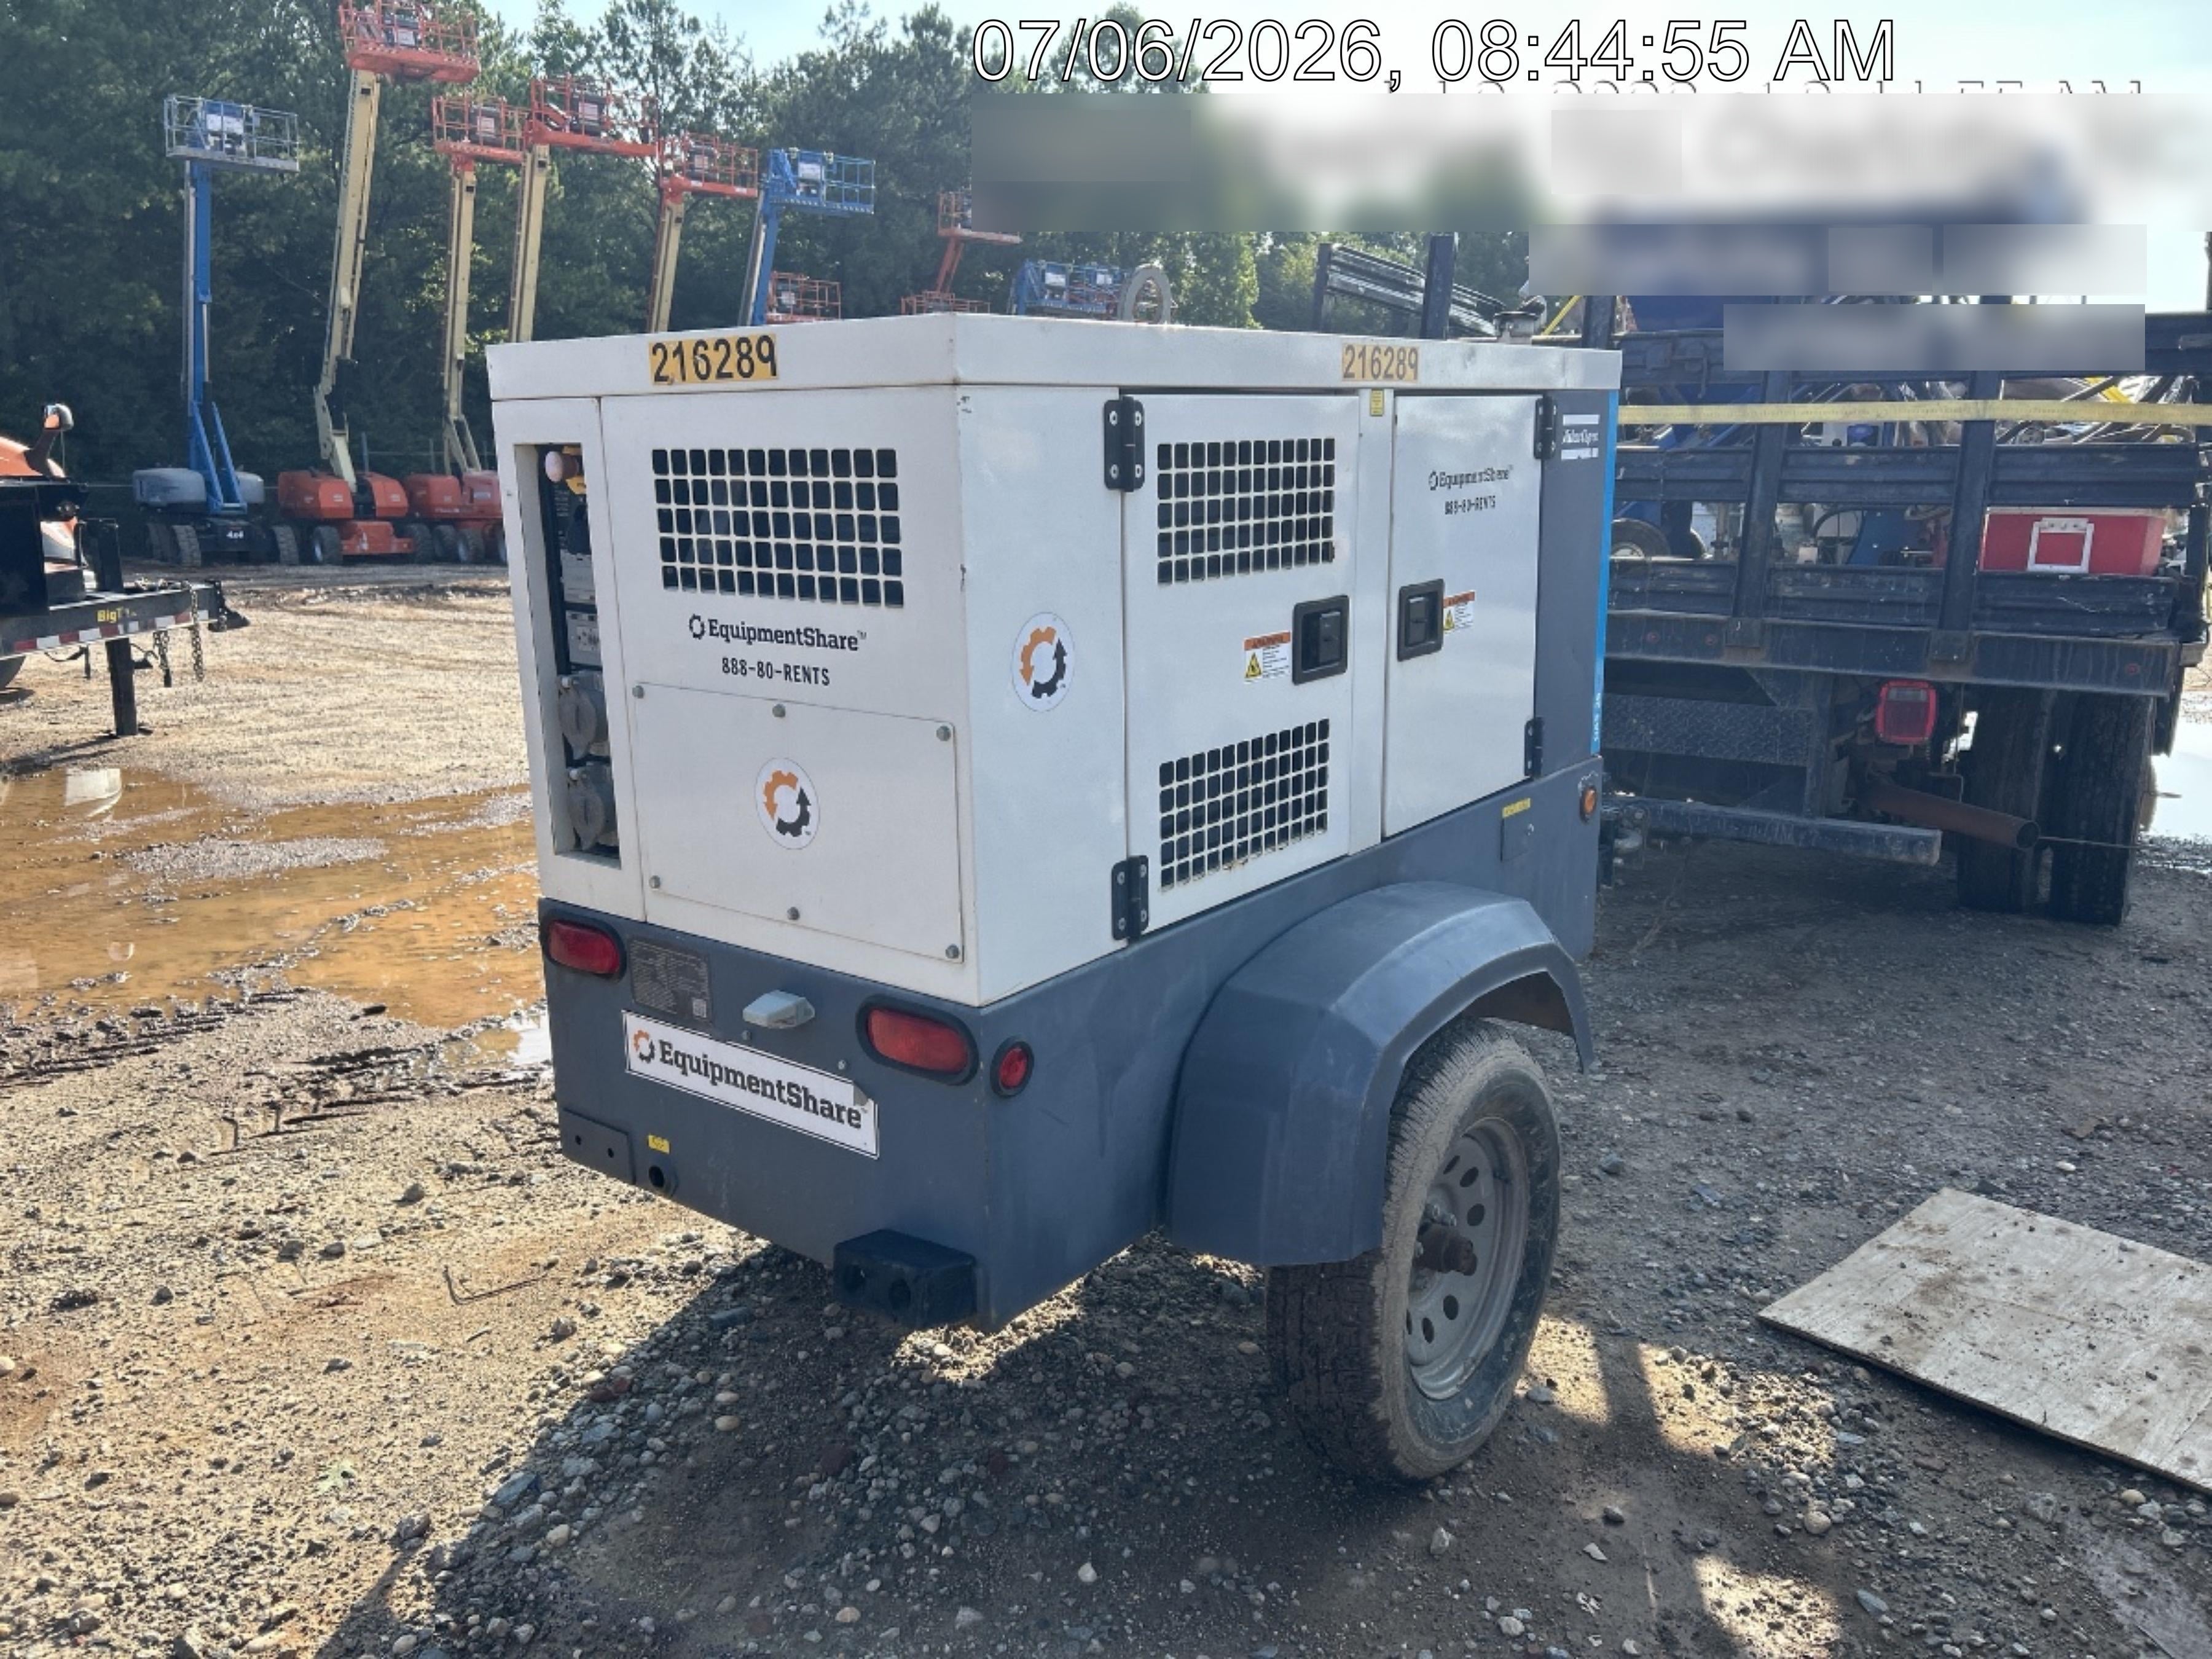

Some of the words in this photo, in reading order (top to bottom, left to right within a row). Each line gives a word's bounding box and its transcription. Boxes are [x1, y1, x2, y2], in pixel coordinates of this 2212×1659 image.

[652, 335, 777, 382] 216289
[1343, 344, 1419, 380] 216289
[707, 618, 859, 651] EquipmentShare
[722, 657, 830, 686] 888-80-RENTS
[659, 1039, 861, 1129] EquipmentShare
